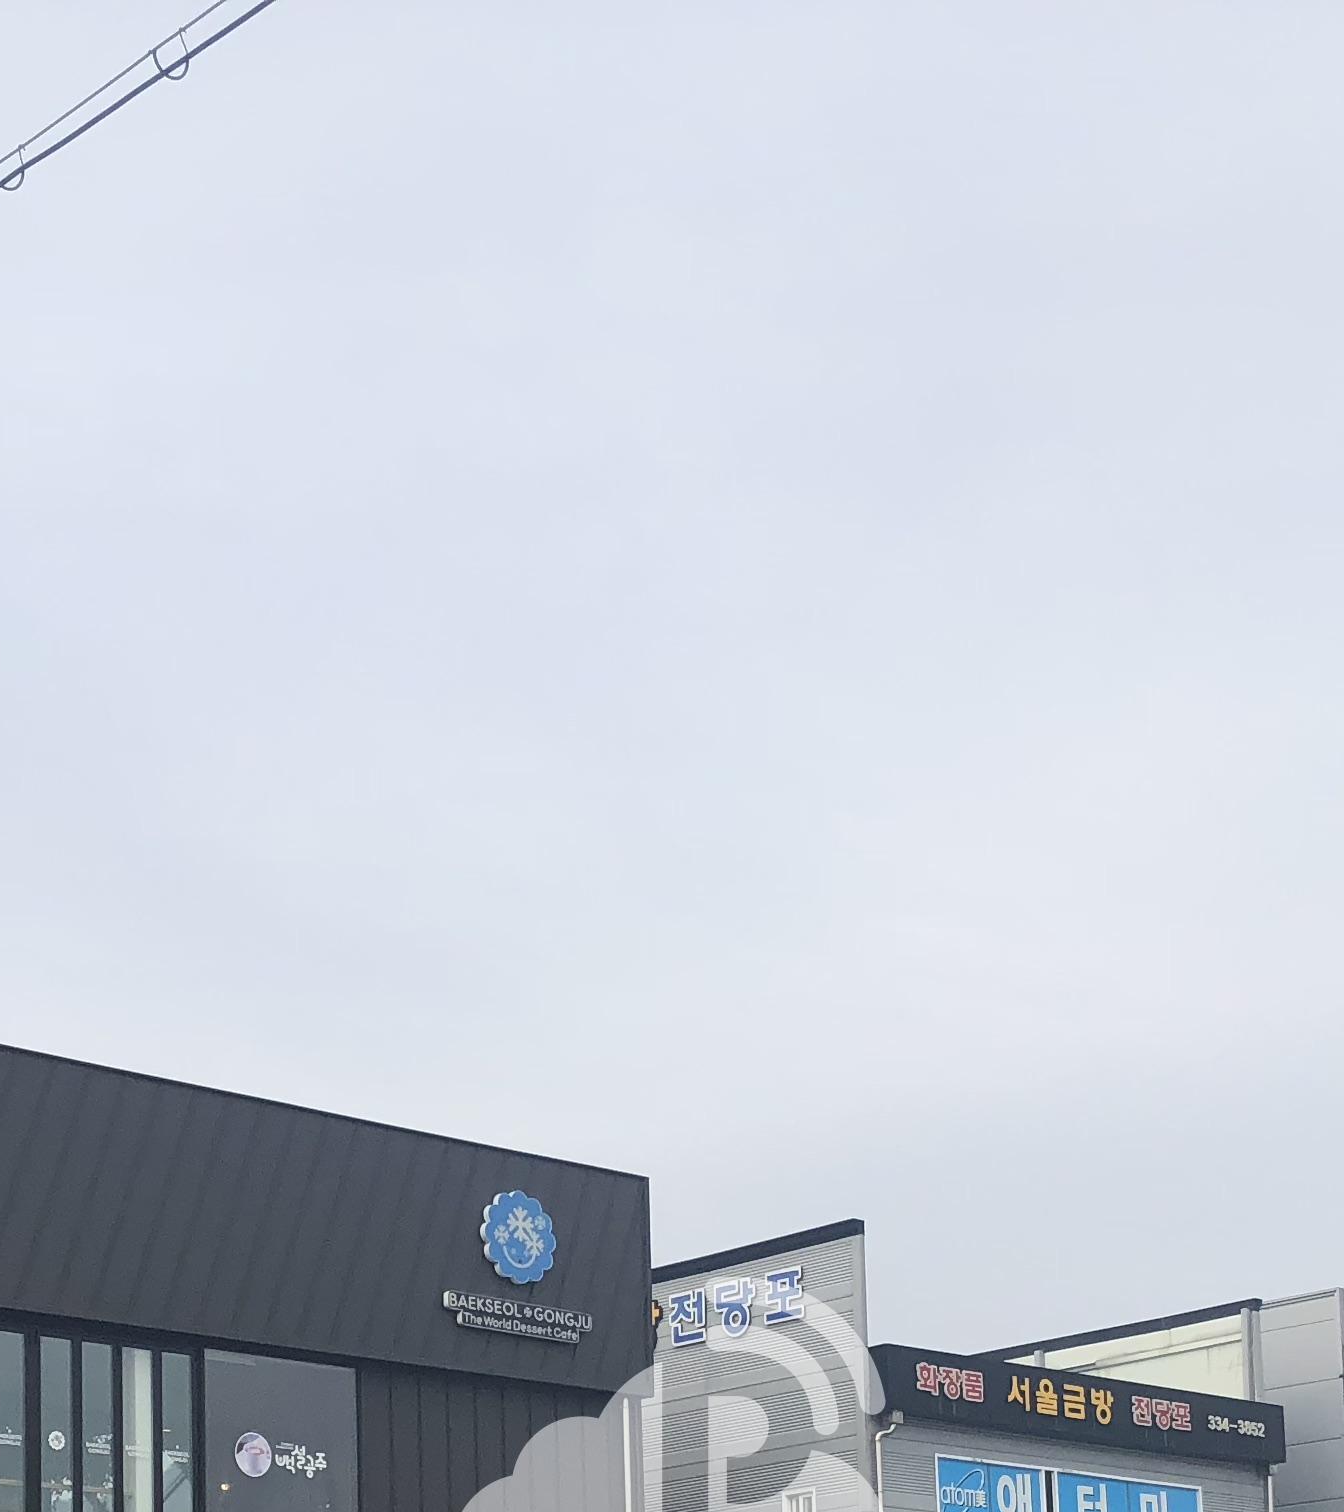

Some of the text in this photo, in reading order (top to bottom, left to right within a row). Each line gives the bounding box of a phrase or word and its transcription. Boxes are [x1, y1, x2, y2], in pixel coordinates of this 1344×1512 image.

[449, 1292, 592, 1329] BAEKSEOL GONGJU
[668, 1265, 805, 1347] 전당포
[463, 1312, 578, 1341] The World Dessert Cafe
[916, 1361, 985, 1403] 화장품
[1007, 1375, 1114, 1425] 서울금방
[1131, 1395, 1192, 1432] 전당포
[274, 1444, 327, 1479] 백설공주
